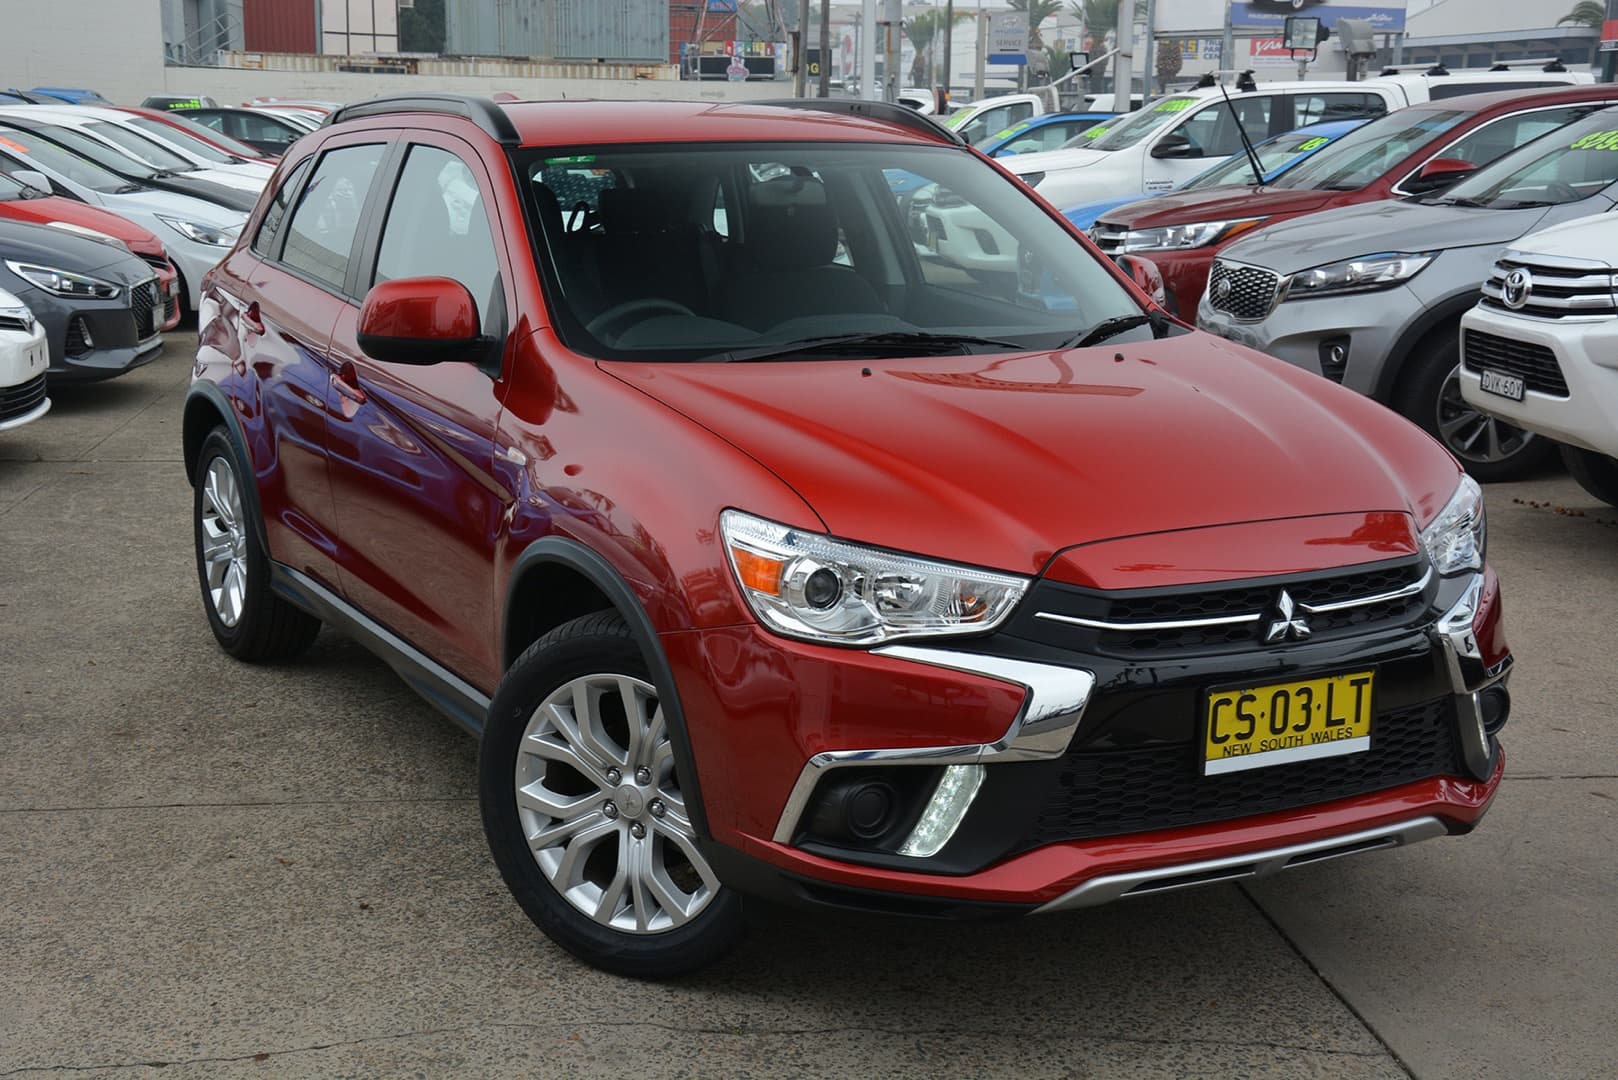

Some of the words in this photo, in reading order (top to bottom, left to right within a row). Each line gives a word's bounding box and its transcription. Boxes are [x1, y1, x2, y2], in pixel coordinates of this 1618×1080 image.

[1223, 743, 1252, 757] NEW
[1259, 735, 1304, 751] SOUTH
[1310, 726, 1353, 743] WALES
